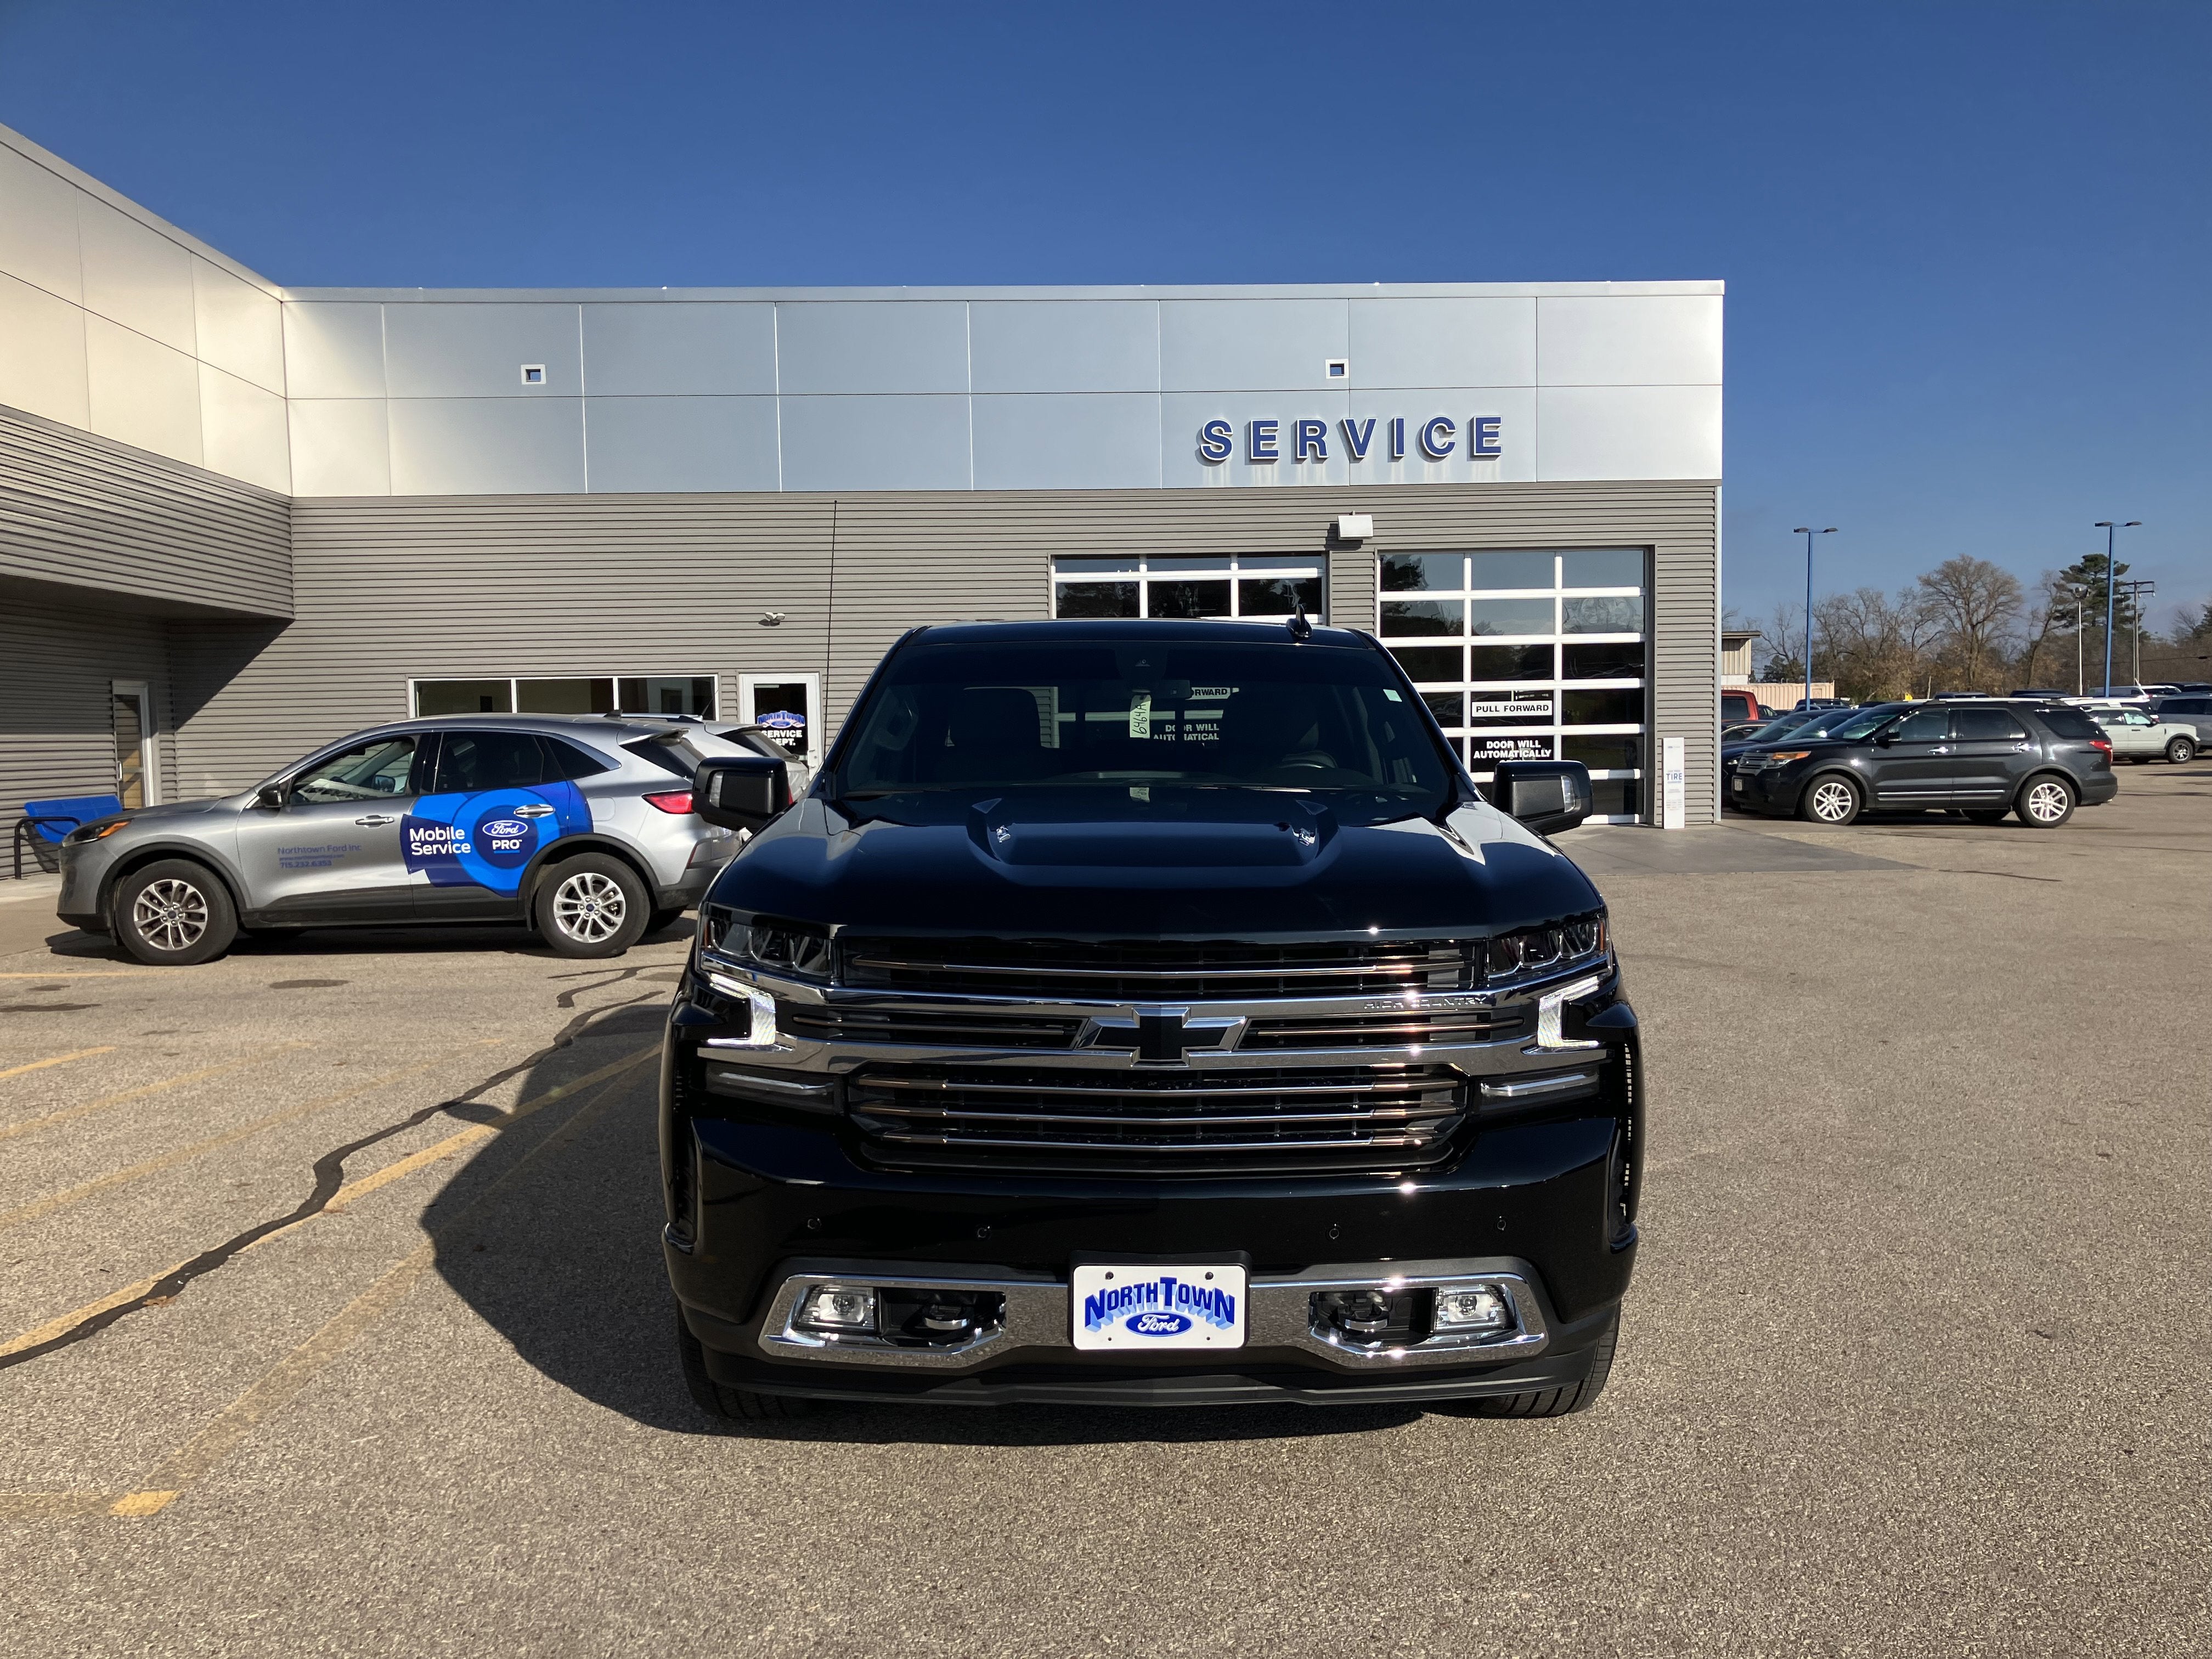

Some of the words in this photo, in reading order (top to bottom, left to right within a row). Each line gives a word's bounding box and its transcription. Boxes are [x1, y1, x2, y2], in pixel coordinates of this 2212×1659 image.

[1200, 415, 1503, 461] SERVICE
[1474, 749, 1551, 759] AUTOMATICALLY
[409, 826, 465, 841] Mobile
[491, 823, 519, 834] Ford
[328, 844, 347, 852] Ford
[411, 842, 471, 855] Service
[492, 839, 521, 850] PRO
[1137, 1314, 1179, 1332] Ford
